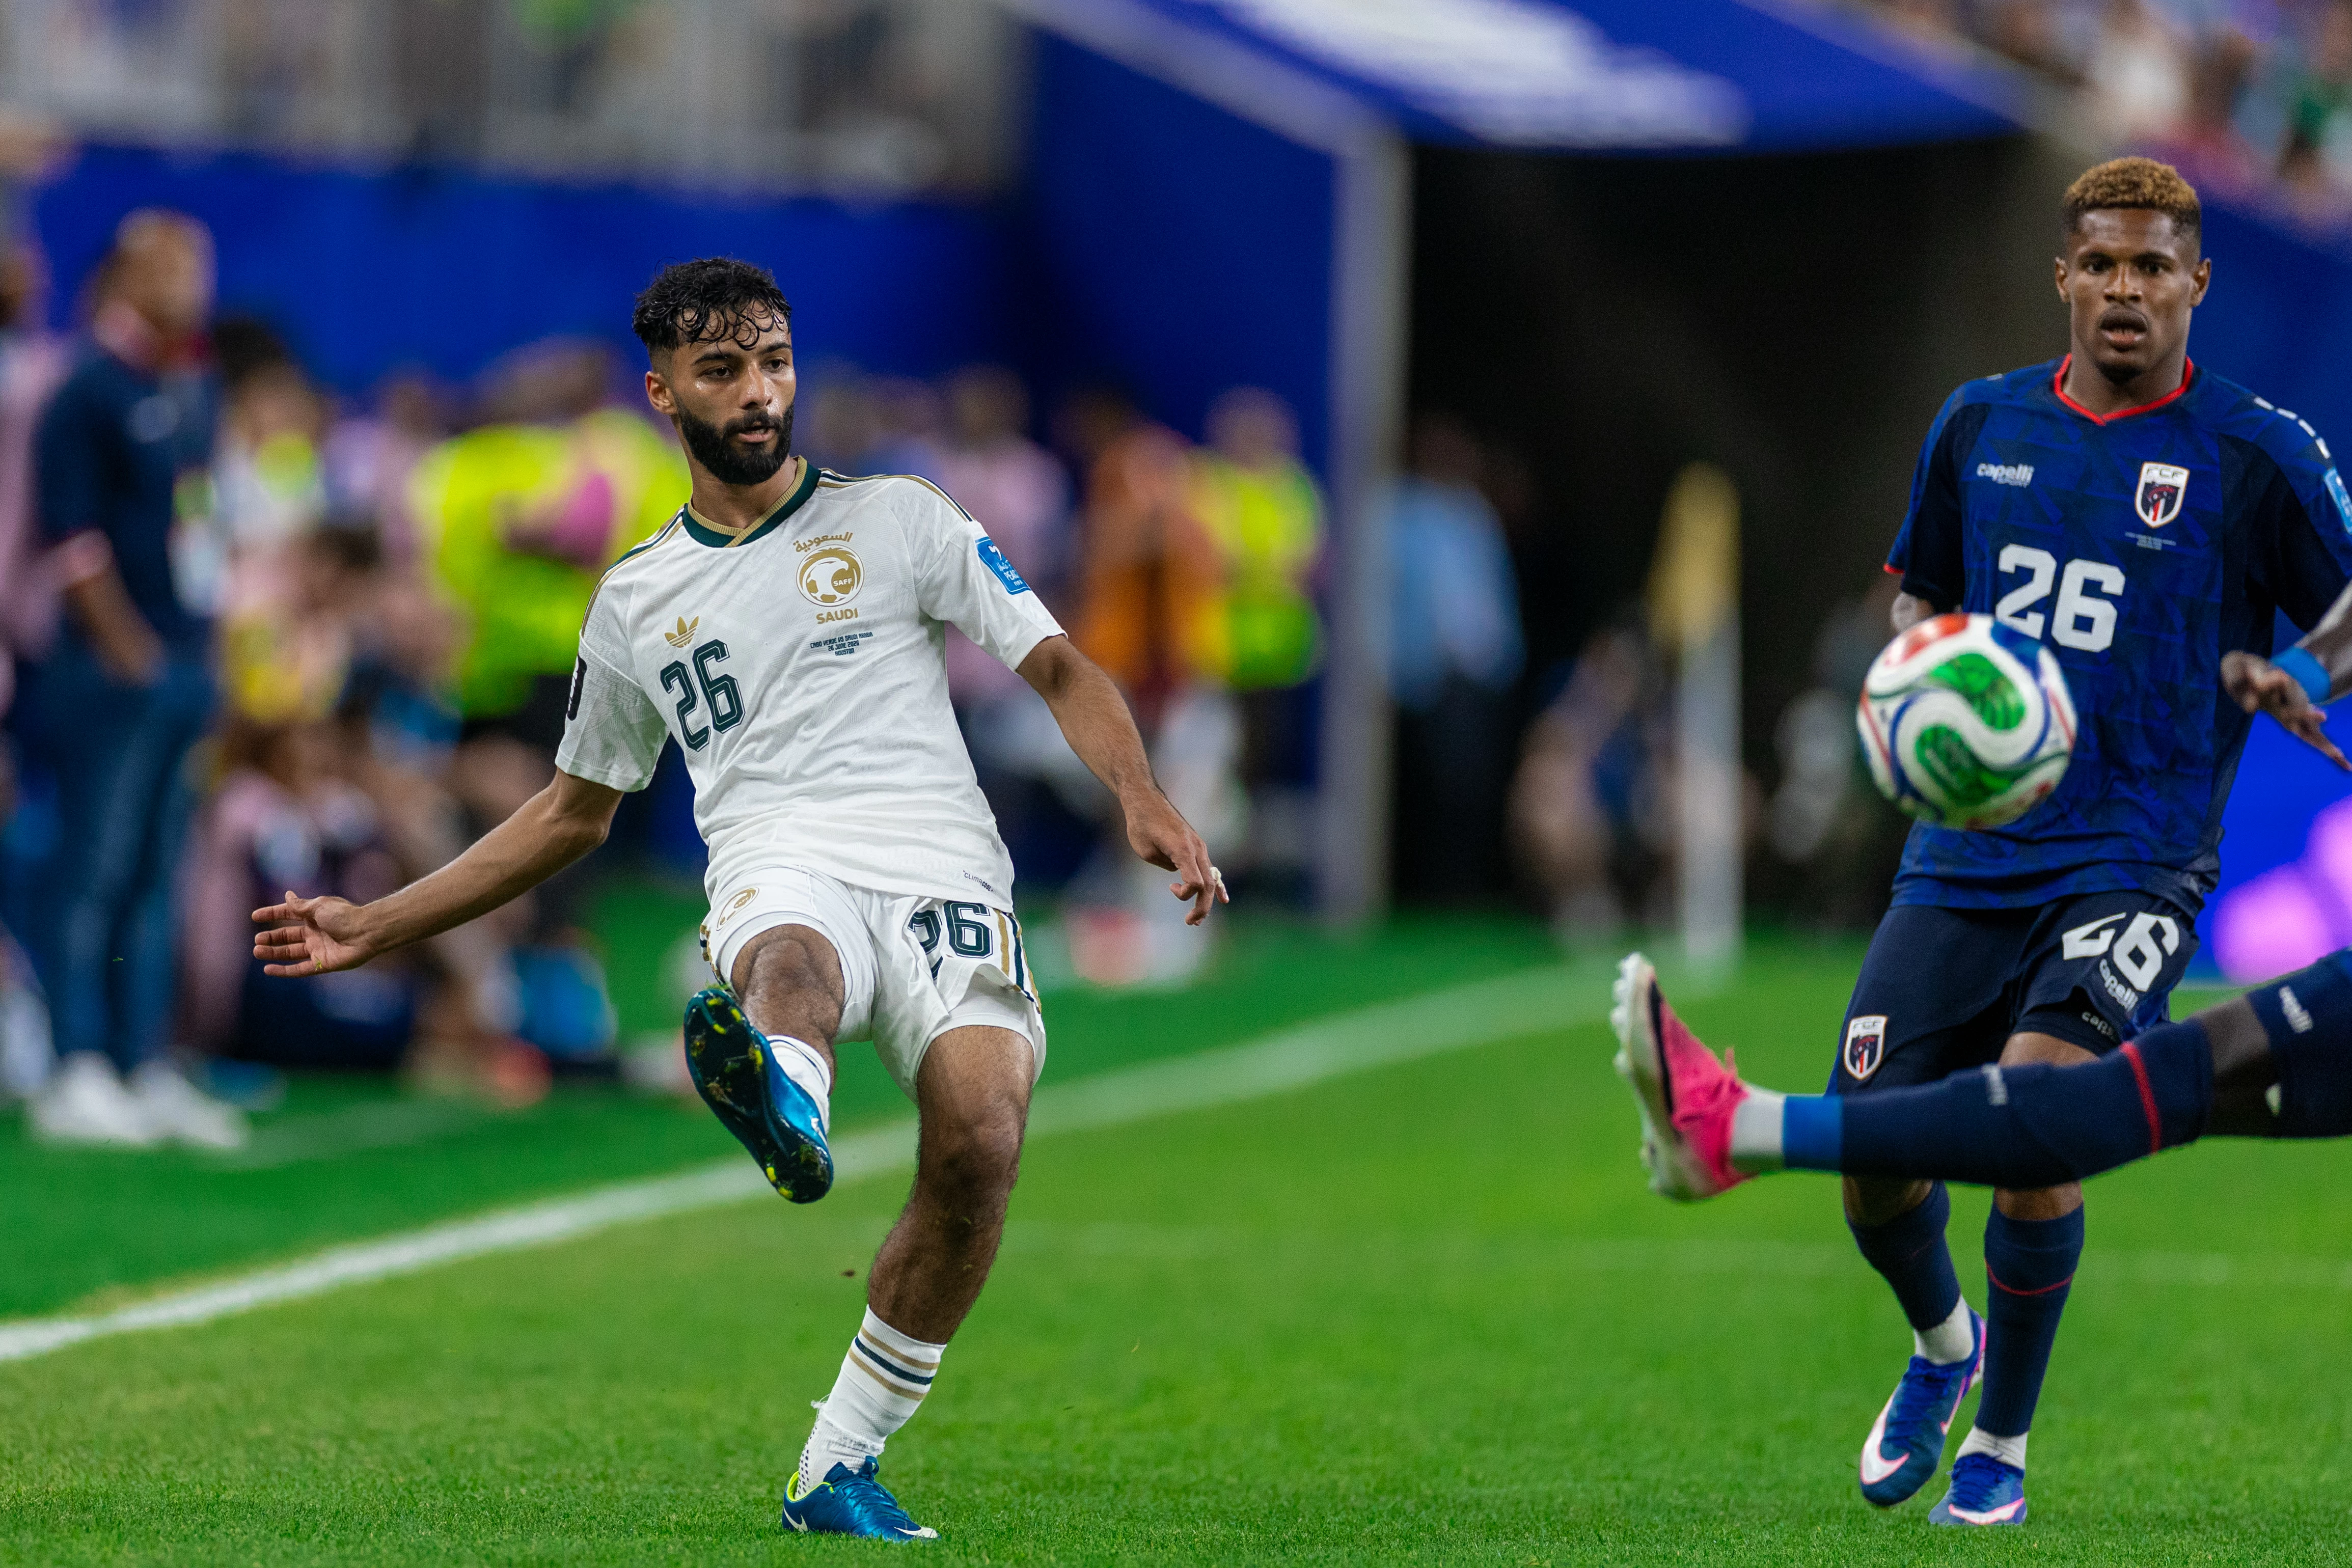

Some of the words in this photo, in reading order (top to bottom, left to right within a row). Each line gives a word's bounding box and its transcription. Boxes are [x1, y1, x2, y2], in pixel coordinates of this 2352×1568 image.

[1977, 463, 2035, 482] capelli
[2146, 467, 2184, 478] FCF
[793, 532, 854, 553] السعودية
[833, 577, 853, 586] SAFF
[1003, 570, 1020, 581] PEAC
[1995, 543, 2126, 653] 26
[816, 608, 859, 624] SAUDI
[823, 638, 837, 646] VERDE
[834, 647, 855, 656] HOUSTON
[660, 639, 746, 753] 26
[908, 900, 993, 981] 26
[2062, 912, 2180, 992] 26
[2099, 958, 2138, 1009] capelli
